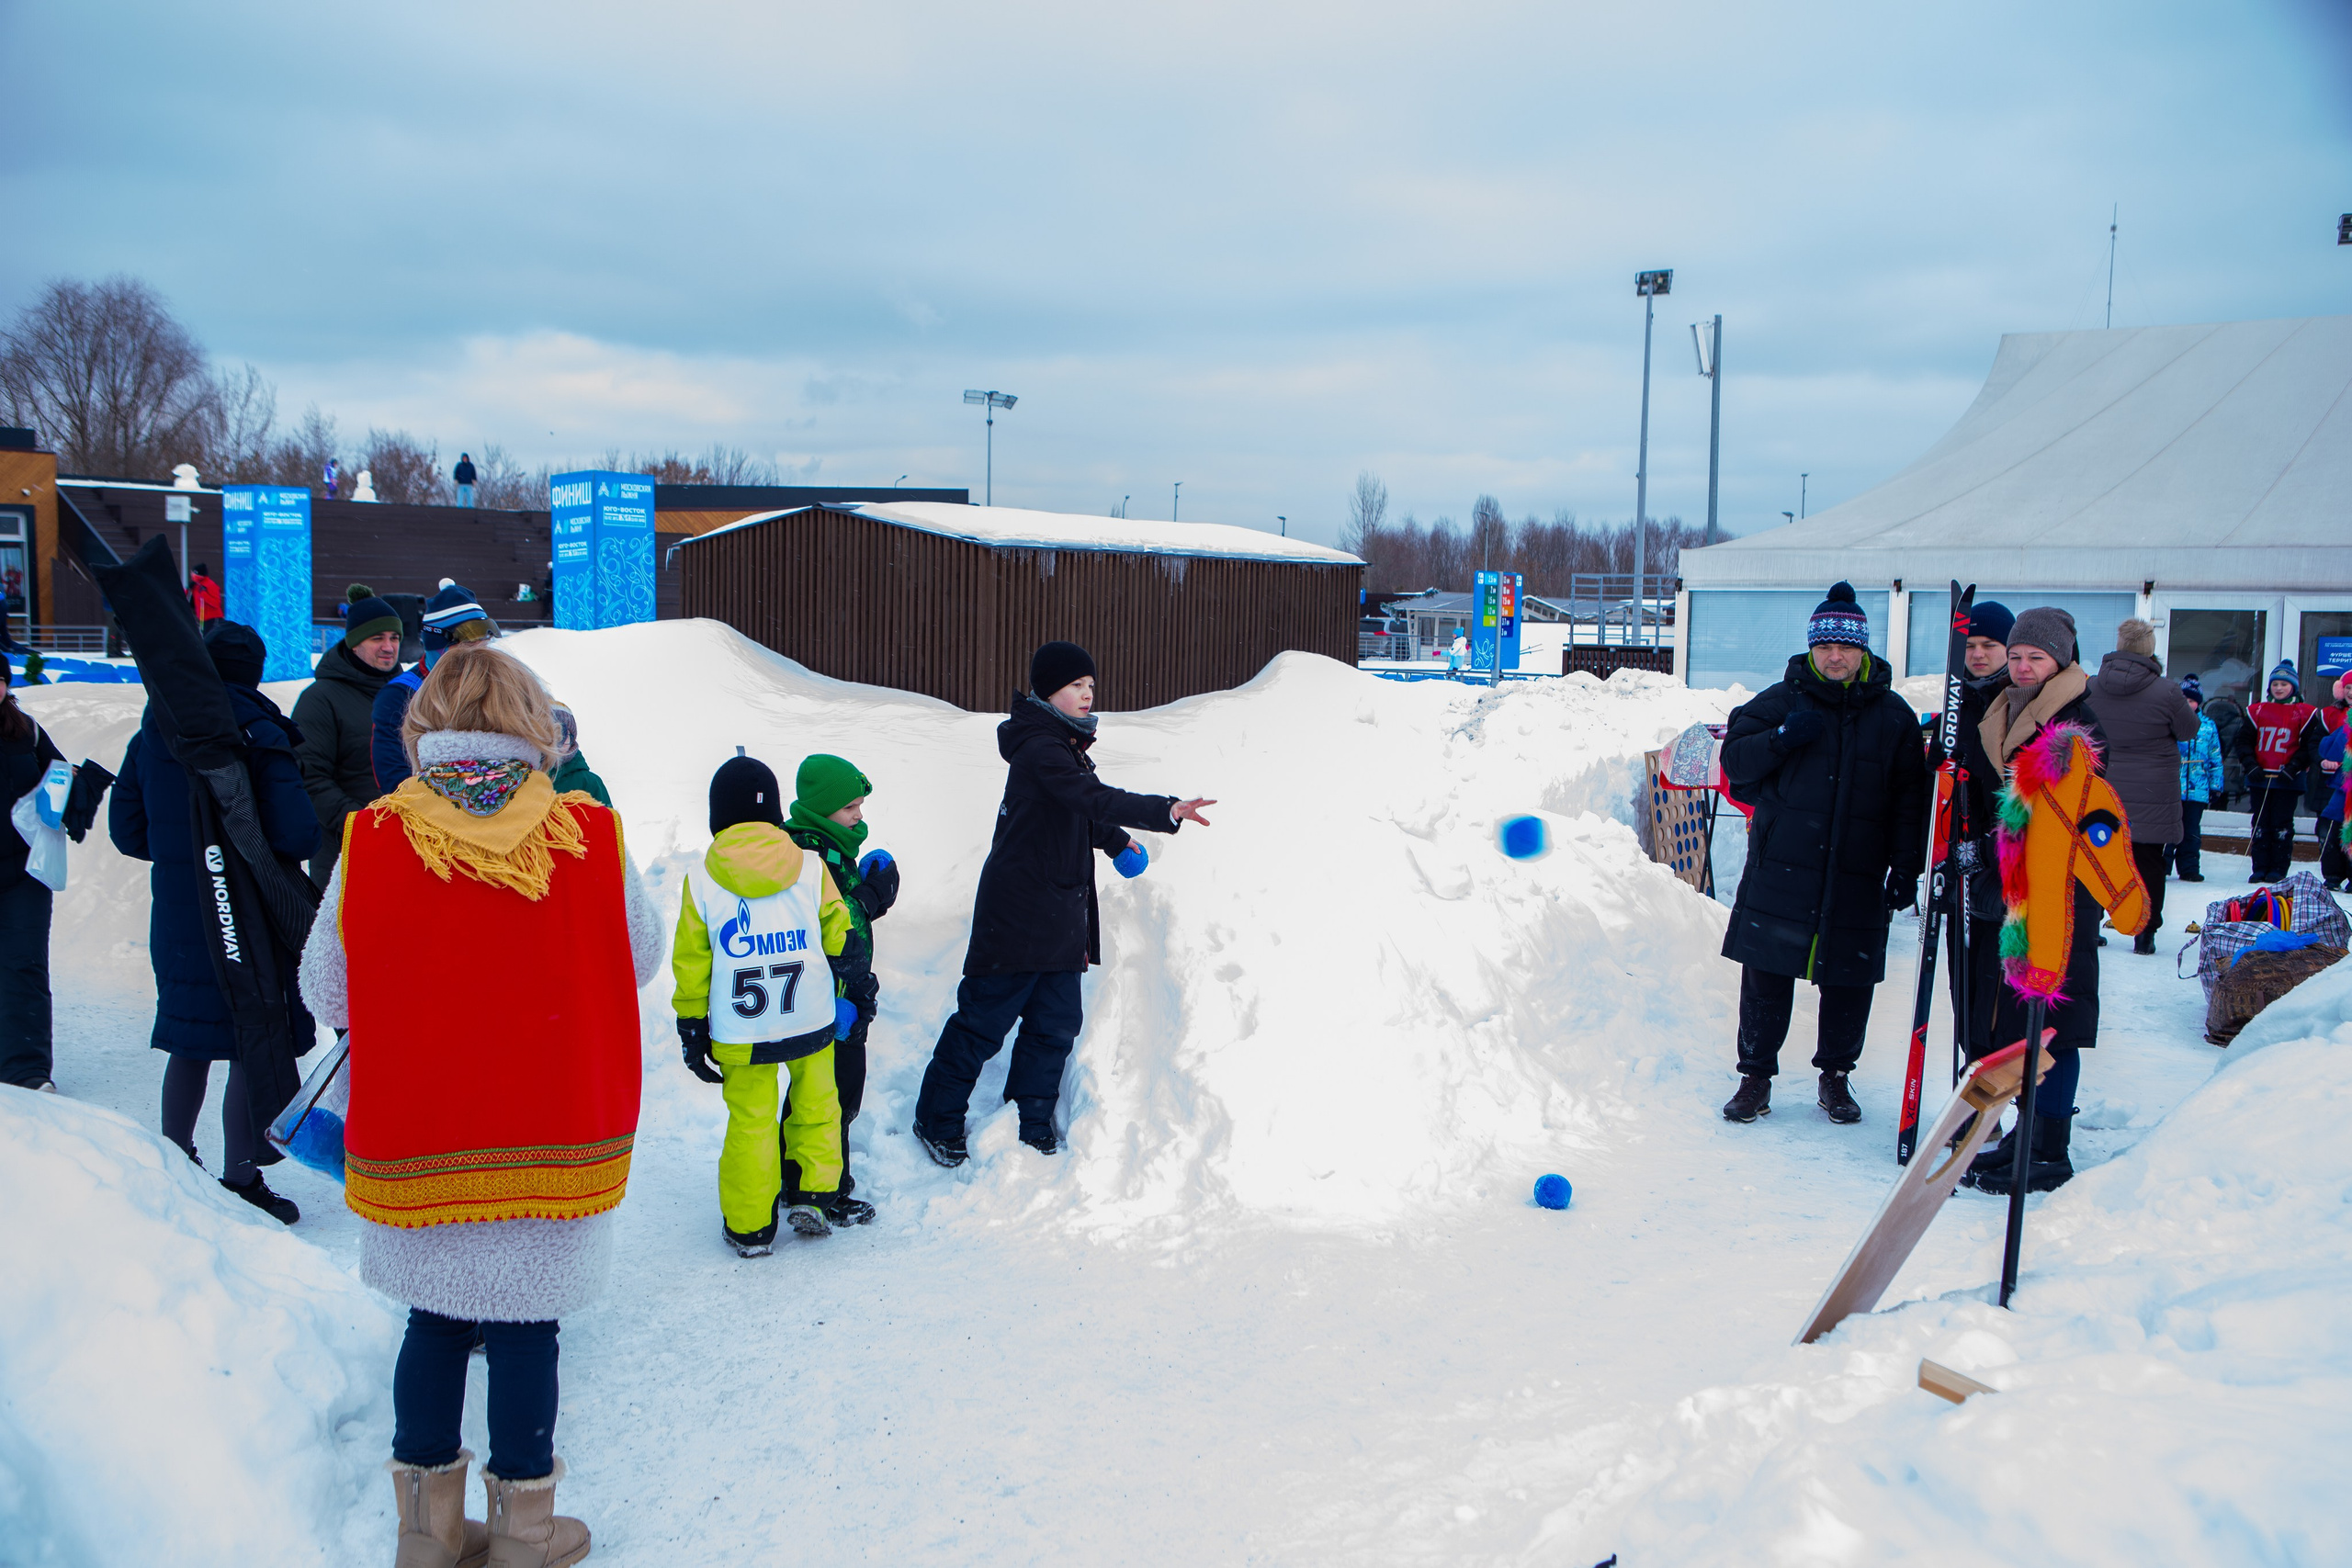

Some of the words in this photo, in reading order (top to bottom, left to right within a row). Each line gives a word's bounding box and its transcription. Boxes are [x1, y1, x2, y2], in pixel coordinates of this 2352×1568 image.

[552, 481, 592, 508] ФИНИШ
[603, 506, 646, 514] ЮГО-ВОСТОК
[2258, 726, 2291, 753] 172
[211, 875, 242, 964] NORDWAY
[756, 929, 808, 956] МОЭК
[731, 960, 805, 1020] 57
[1908, 1078, 1917, 1100] SKIN
[1906, 1101, 1917, 1122] XC
[1900, 1143, 1908, 1157] 187
